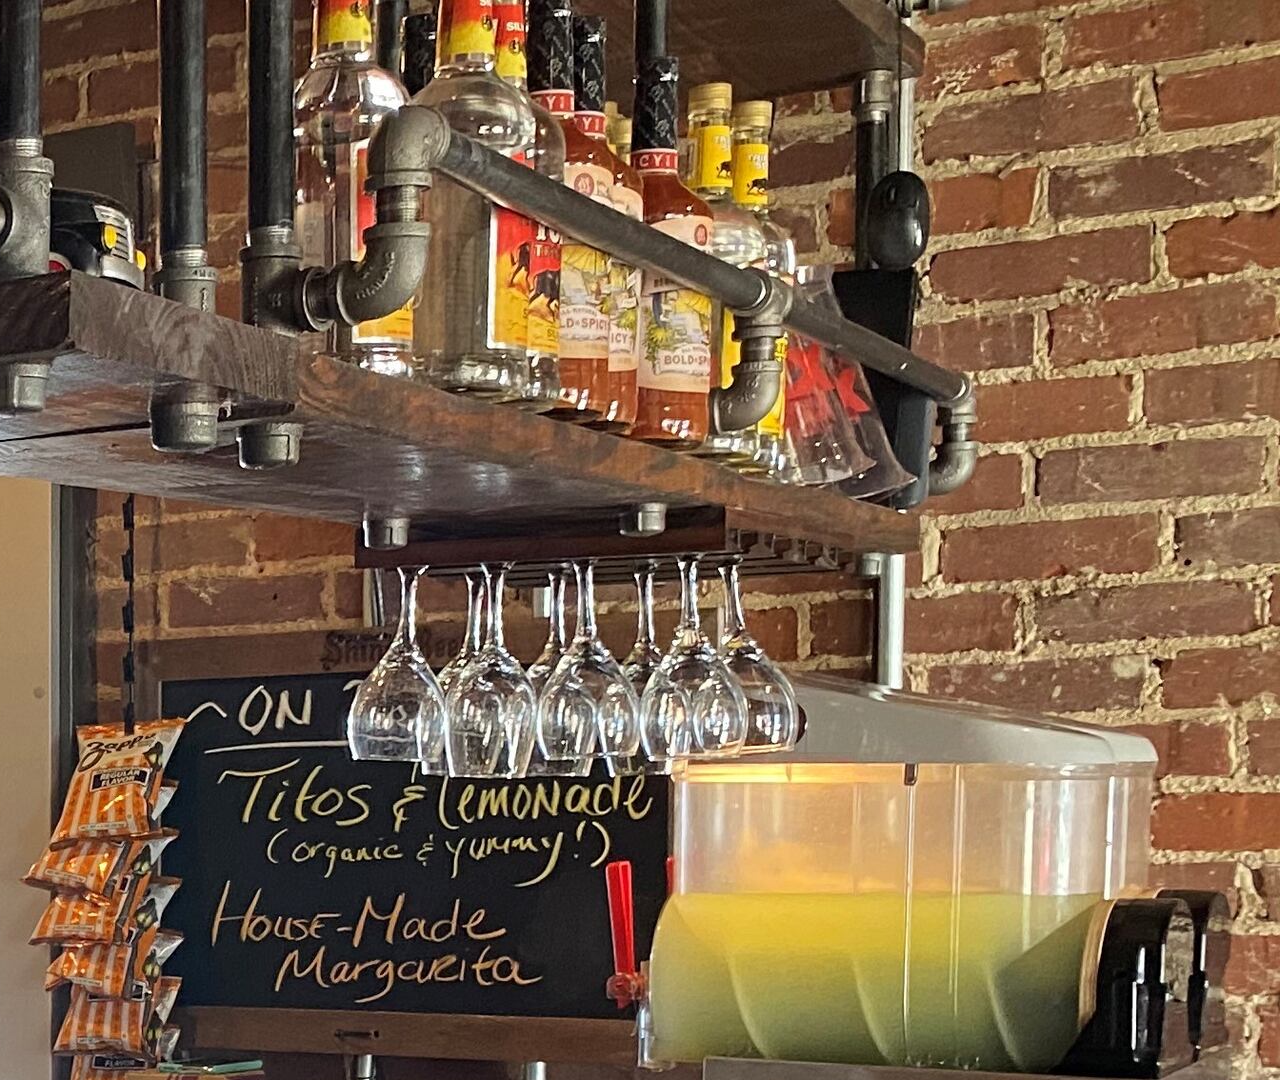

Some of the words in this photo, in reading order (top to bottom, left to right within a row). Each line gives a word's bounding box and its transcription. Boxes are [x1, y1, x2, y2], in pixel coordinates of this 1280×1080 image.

[664, 354, 693, 366] BOLD
[238, 684, 312, 736] ON
[217, 757, 372, 828] Titos
[266, 827, 404, 879] (organic
